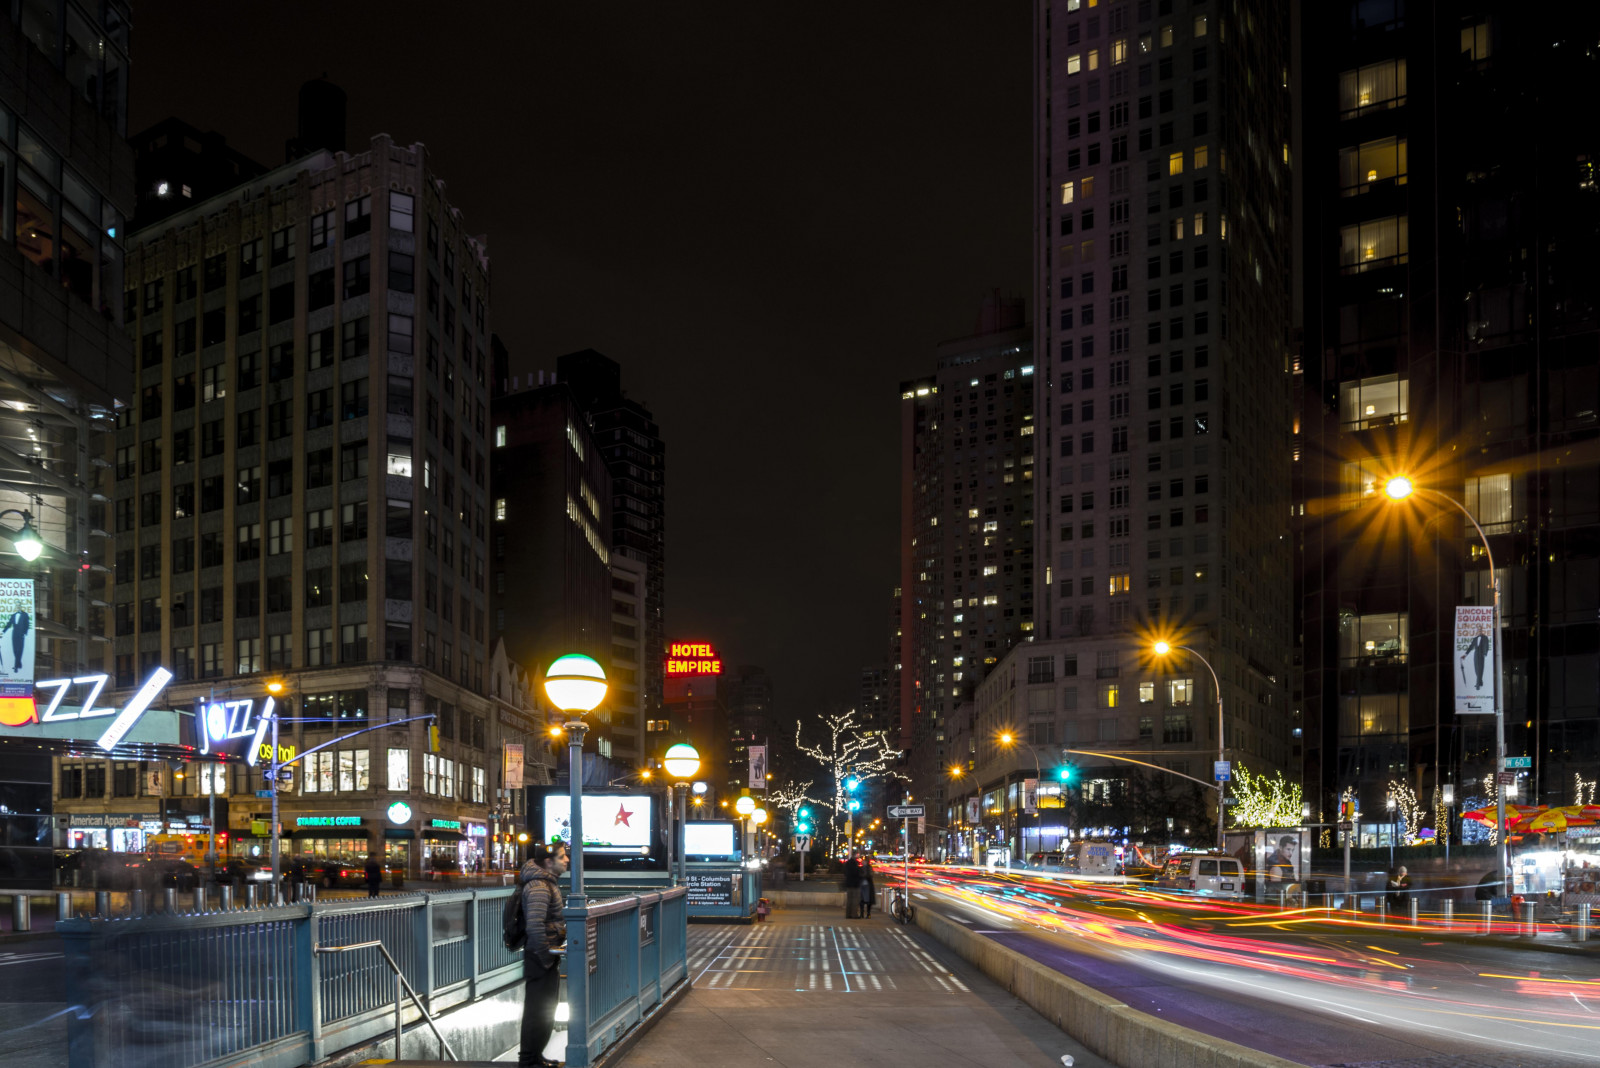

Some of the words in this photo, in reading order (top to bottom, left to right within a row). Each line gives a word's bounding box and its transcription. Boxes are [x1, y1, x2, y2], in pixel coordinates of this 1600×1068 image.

[0, 581, 32, 589] NCOLN
[0, 589, 32, 597] QUARE
[0, 597, 33, 605] NCOLN
[672, 644, 714, 657] HOTEL
[667, 660, 720, 673] EMPIRE
[277, 743, 296, 762] hall
[1514, 758, 1525, 767] 60
[909, 807, 921, 815] WAY
[69, 814, 103, 826] American
[296, 816, 335, 827] STARBUCKS
[335, 816, 361, 826] COFFEE
